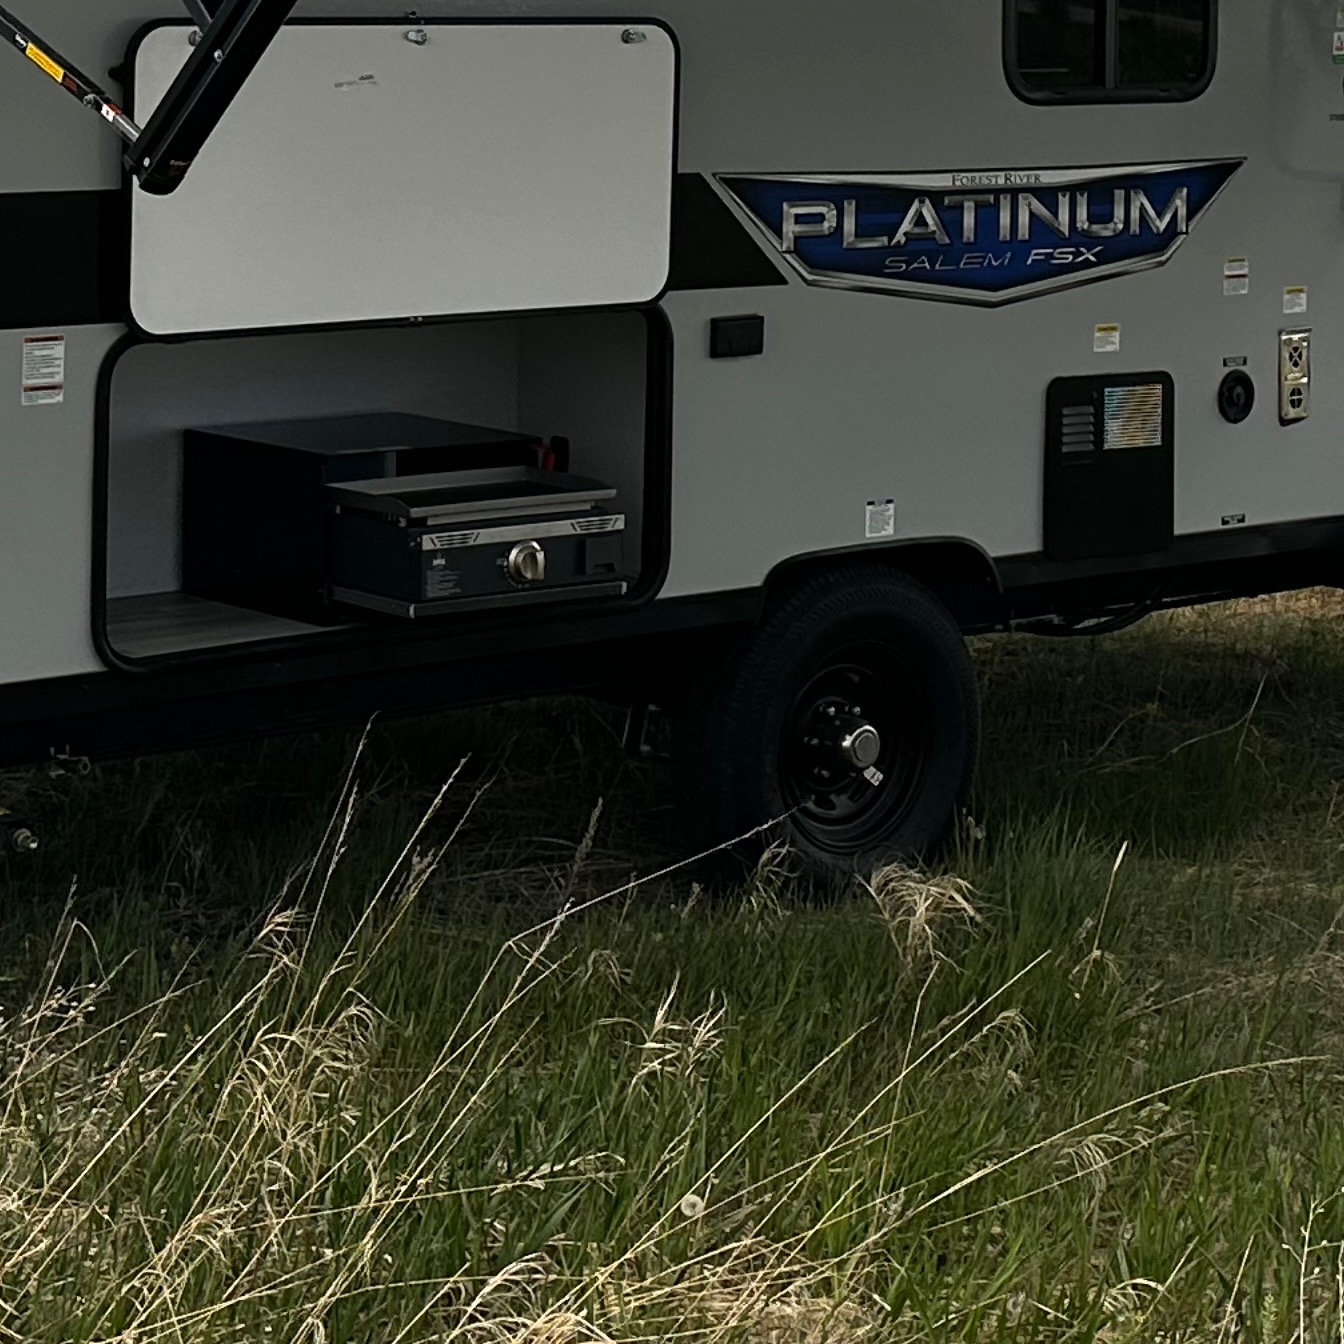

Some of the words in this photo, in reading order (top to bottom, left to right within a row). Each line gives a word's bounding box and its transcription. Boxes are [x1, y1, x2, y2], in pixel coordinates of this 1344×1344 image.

[951, 172, 1001, 187] FOREST
[1003, 170, 1042, 186] RIVER
[781, 186, 1189, 252] PLATINUM
[883, 251, 1012, 273] SALEM
[1027, 245, 1104, 266] FSX
